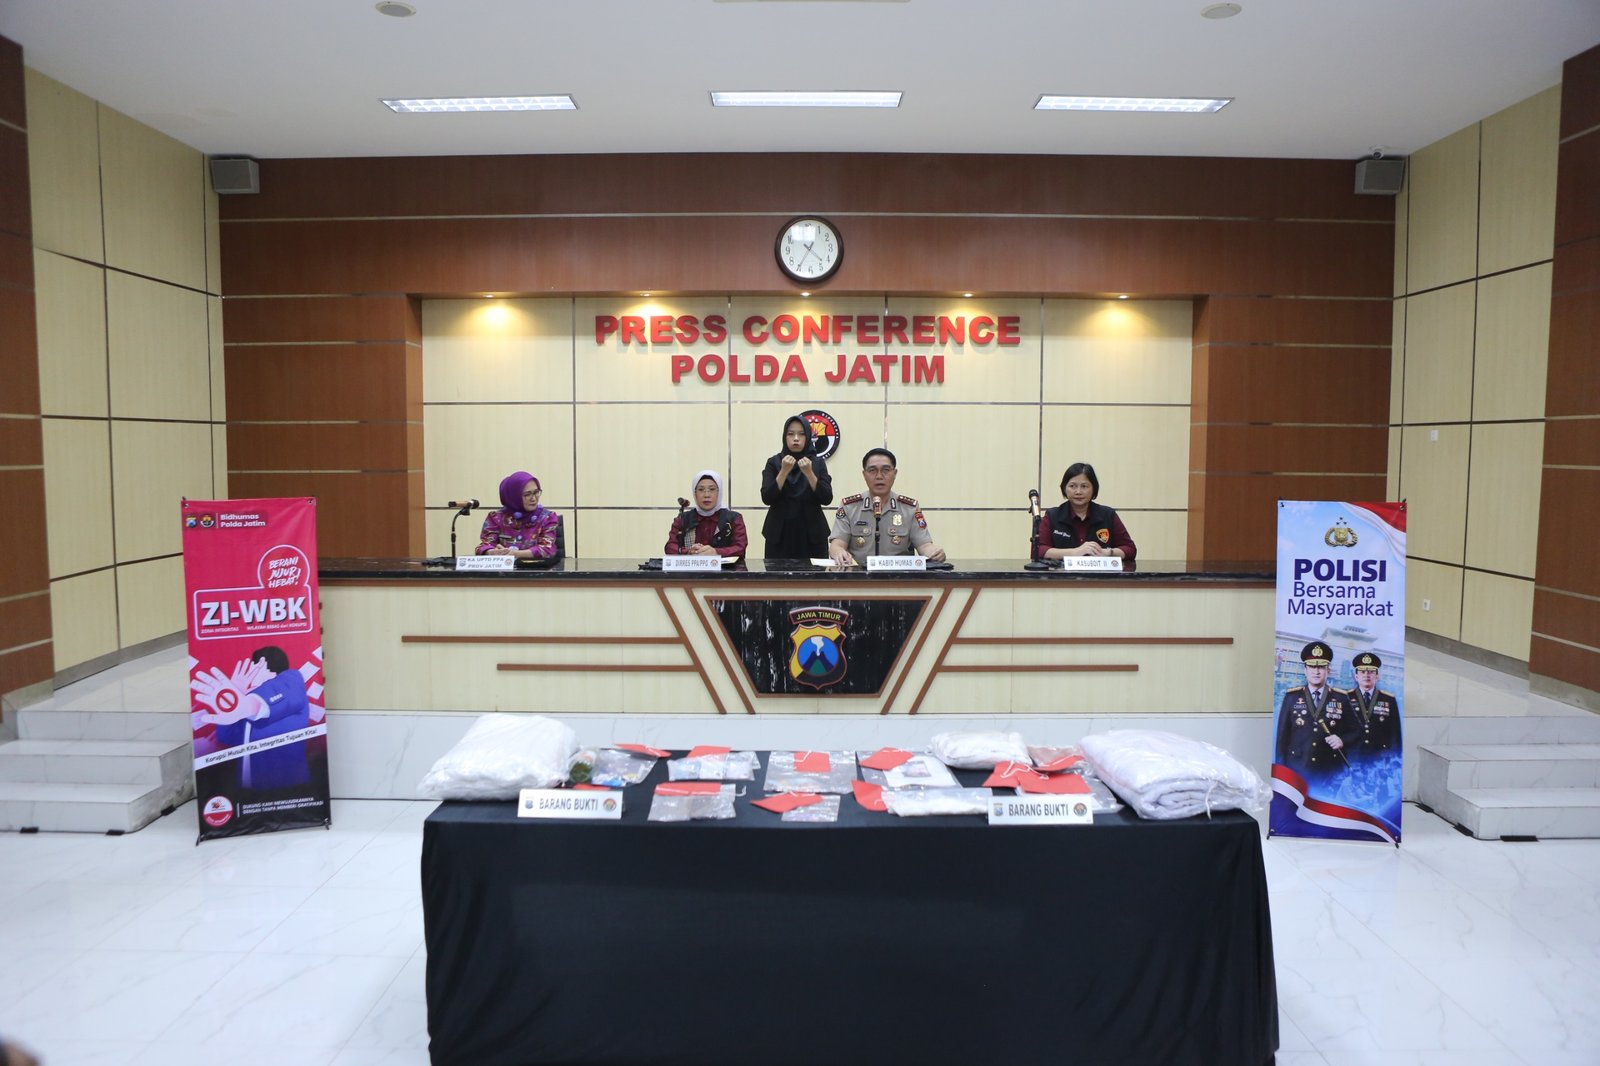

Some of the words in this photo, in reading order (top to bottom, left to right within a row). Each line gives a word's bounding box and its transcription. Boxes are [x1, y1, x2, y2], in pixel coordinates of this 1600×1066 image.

[824, 232, 830, 242] 2
[785, 245, 791, 255] 9
[828, 243, 834, 253] 3
[789, 256, 795, 266] 8
[595, 315, 727, 344] PRESS
[742, 315, 1021, 344] CONFERENCE
[671, 354, 809, 383] POLDA
[824, 354, 945, 383] JATIM
[268, 556, 299, 569] BERANI
[878, 559, 894, 567] KABID
[894, 559, 912, 567] HUMAS
[268, 566, 298, 580] JUJUR
[1294, 558, 1386, 582] POLISI
[1293, 581, 1376, 598] Bersama
[201, 596, 307, 626] ZI-WBK
[1287, 598, 1394, 619] Masyarakat
[797, 612, 817, 620] JAWA
[818, 612, 841, 620] TIMUR
[206, 753, 227, 763] Korupsi
[228, 748, 245, 757] Musuh
[260, 738, 285, 748] Integritas
[285, 732, 304, 743] Tujuan
[540, 798, 572, 810] BARANG
[574, 798, 599, 811] BUKTI
[1008, 803, 1042, 816] BARANG
[1044, 803, 1069, 816] BUKTI
